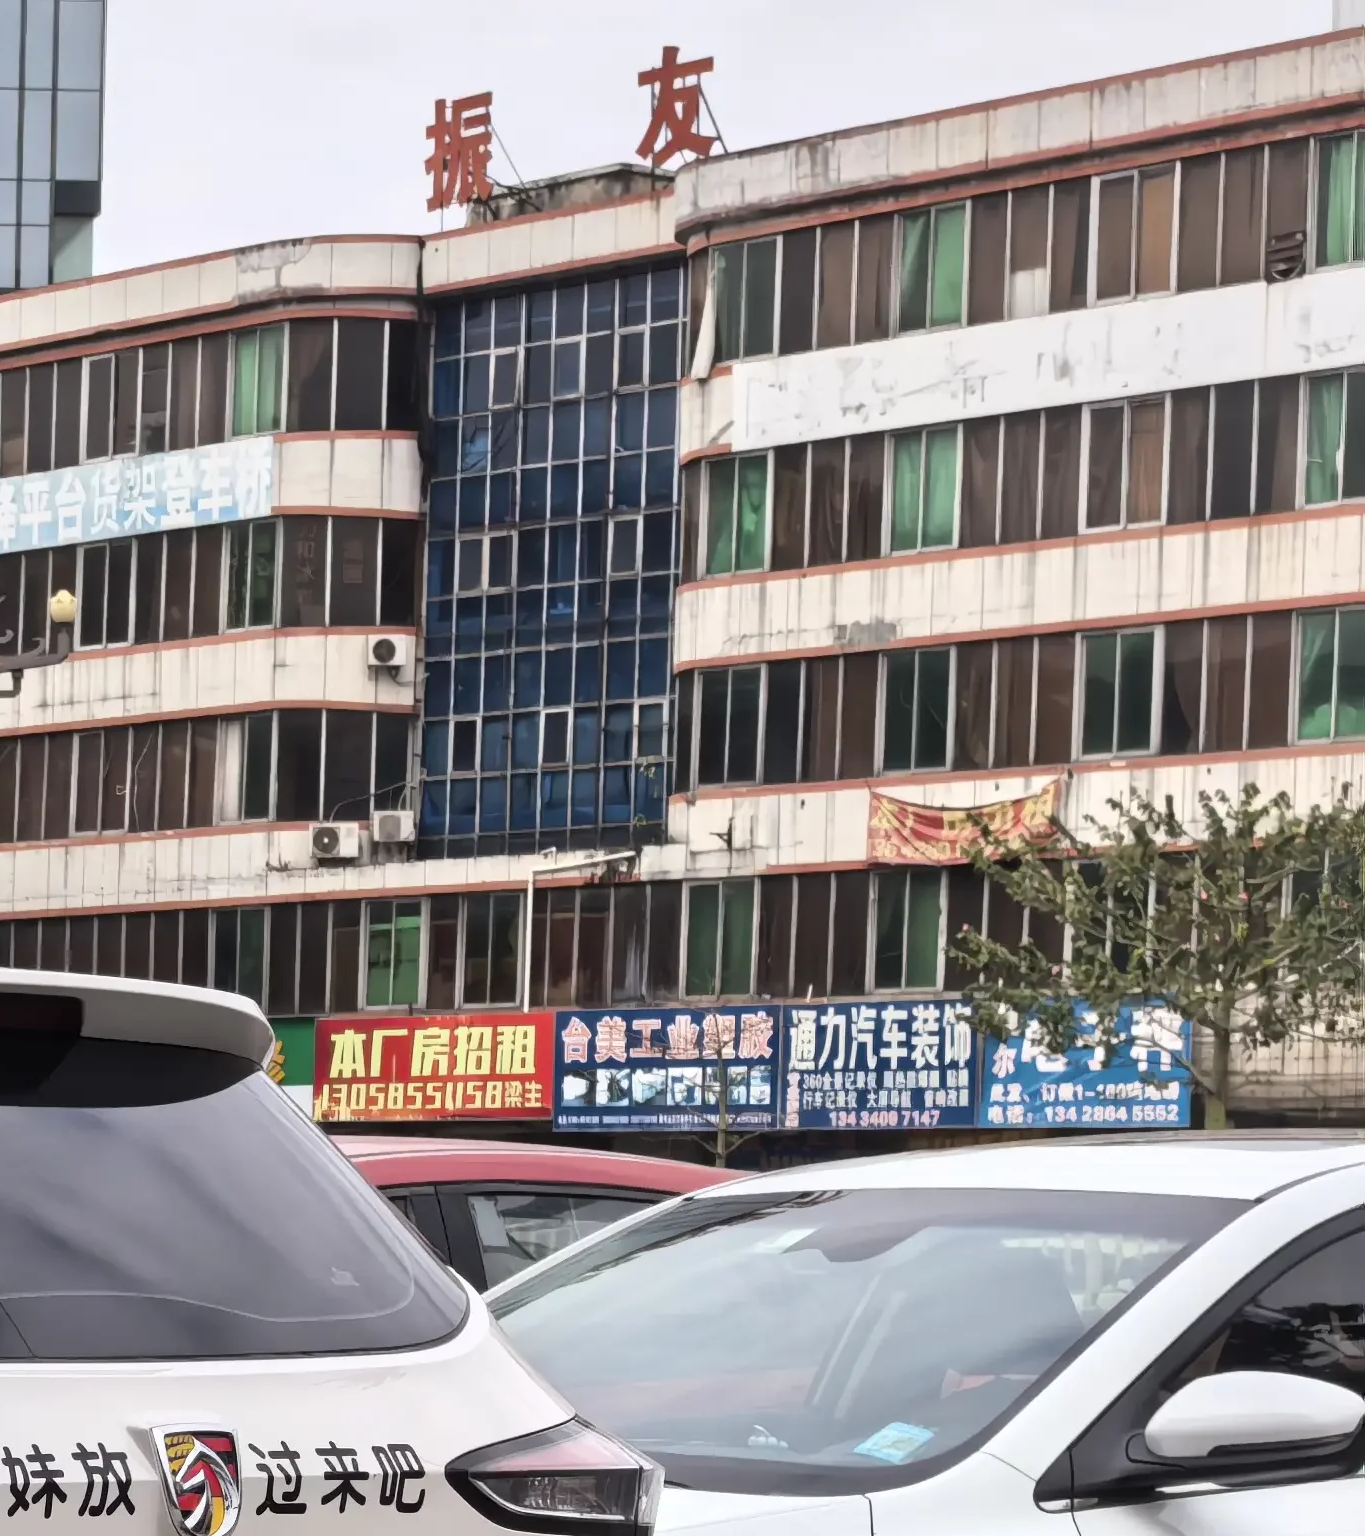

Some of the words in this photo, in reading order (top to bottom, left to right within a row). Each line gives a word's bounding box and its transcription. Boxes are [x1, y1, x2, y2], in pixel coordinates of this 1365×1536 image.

[329, 1025, 536, 1079] 本厂房招租
[788, 1002, 972, 1071] 通力汽车装饰
[248, 1440, 426, 1516] 过来吧
